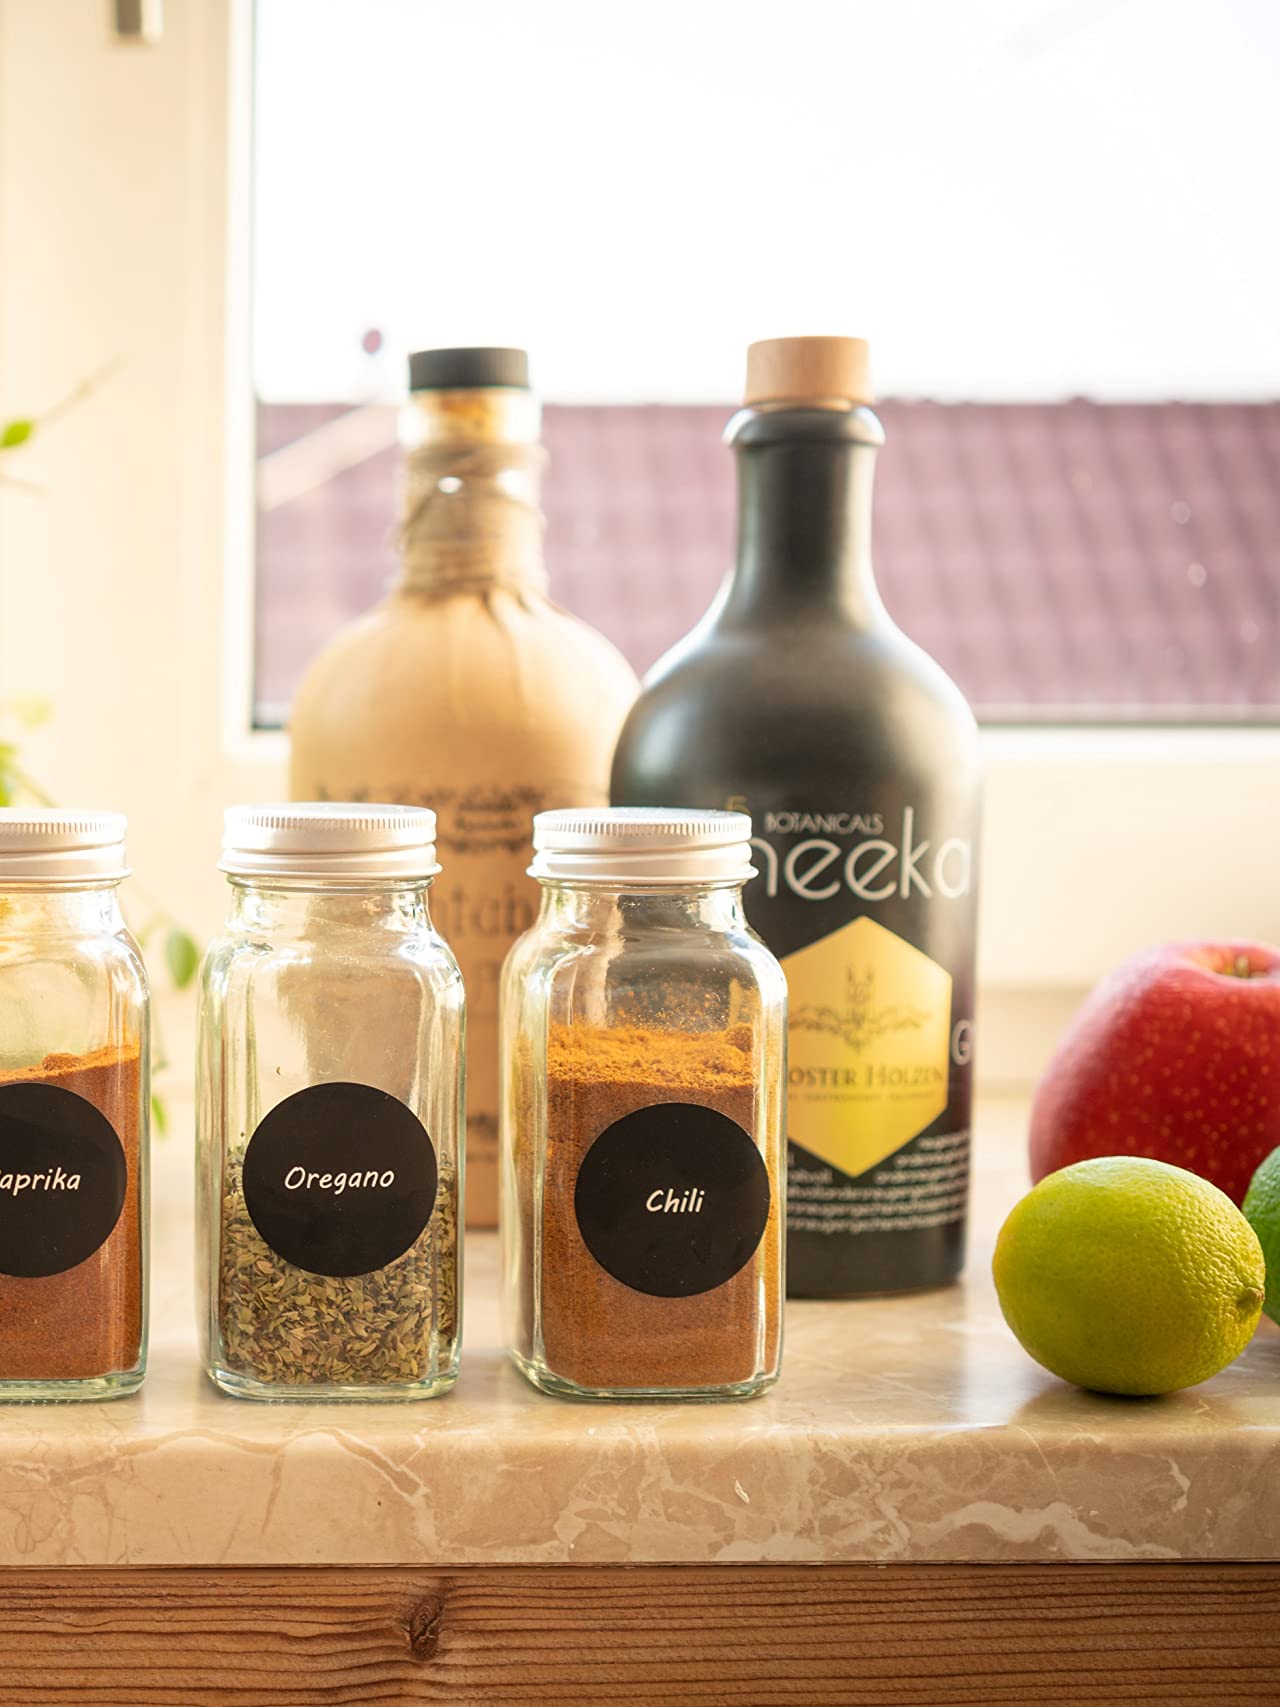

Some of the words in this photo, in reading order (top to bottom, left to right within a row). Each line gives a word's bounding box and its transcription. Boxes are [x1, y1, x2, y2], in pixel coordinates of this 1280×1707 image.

[765, 812, 885, 836] BOTANICALS
[284, 1166, 395, 1195] Oregano
[646, 1187, 705, 1213] Chili
